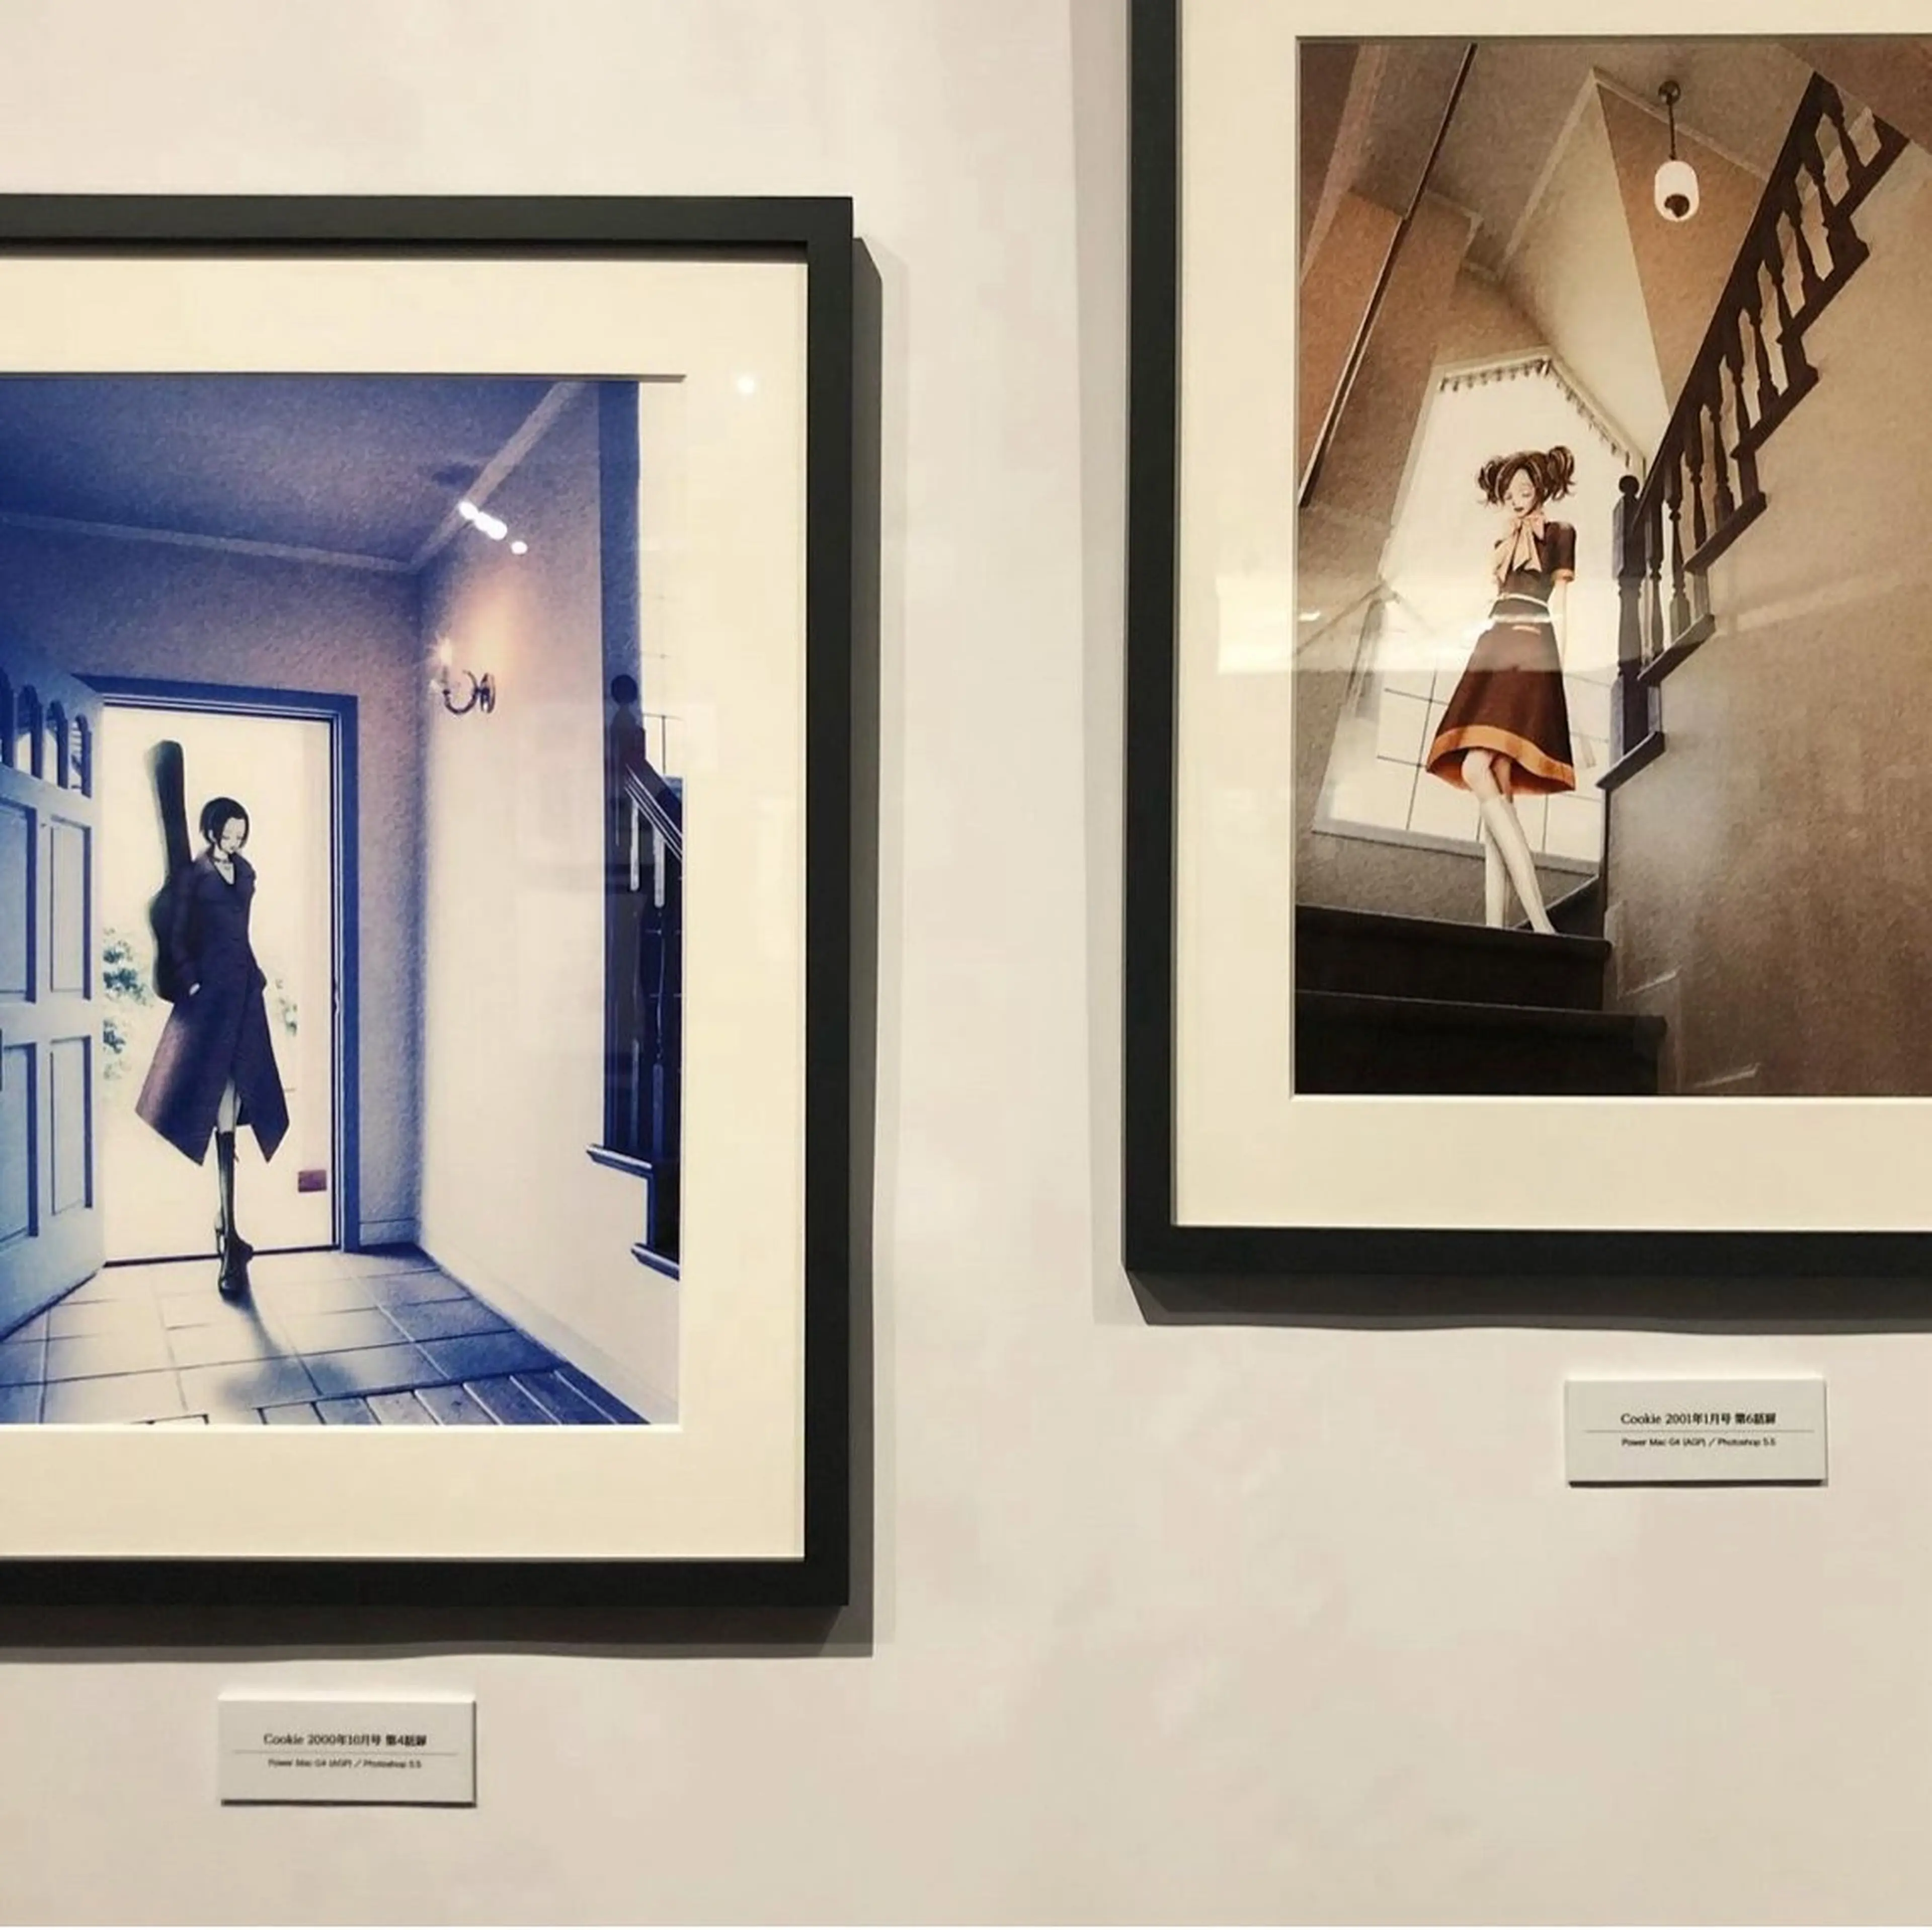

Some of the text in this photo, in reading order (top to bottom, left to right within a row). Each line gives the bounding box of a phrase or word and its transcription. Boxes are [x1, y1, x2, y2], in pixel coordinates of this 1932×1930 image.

[1621, 1412, 1662, 1424] Cookie
[1665, 1412, 1731, 1425] 2001年1月号
[263, 1733, 305, 1745] Cookie
[308, 1734, 381, 1746] 2000年10月号
